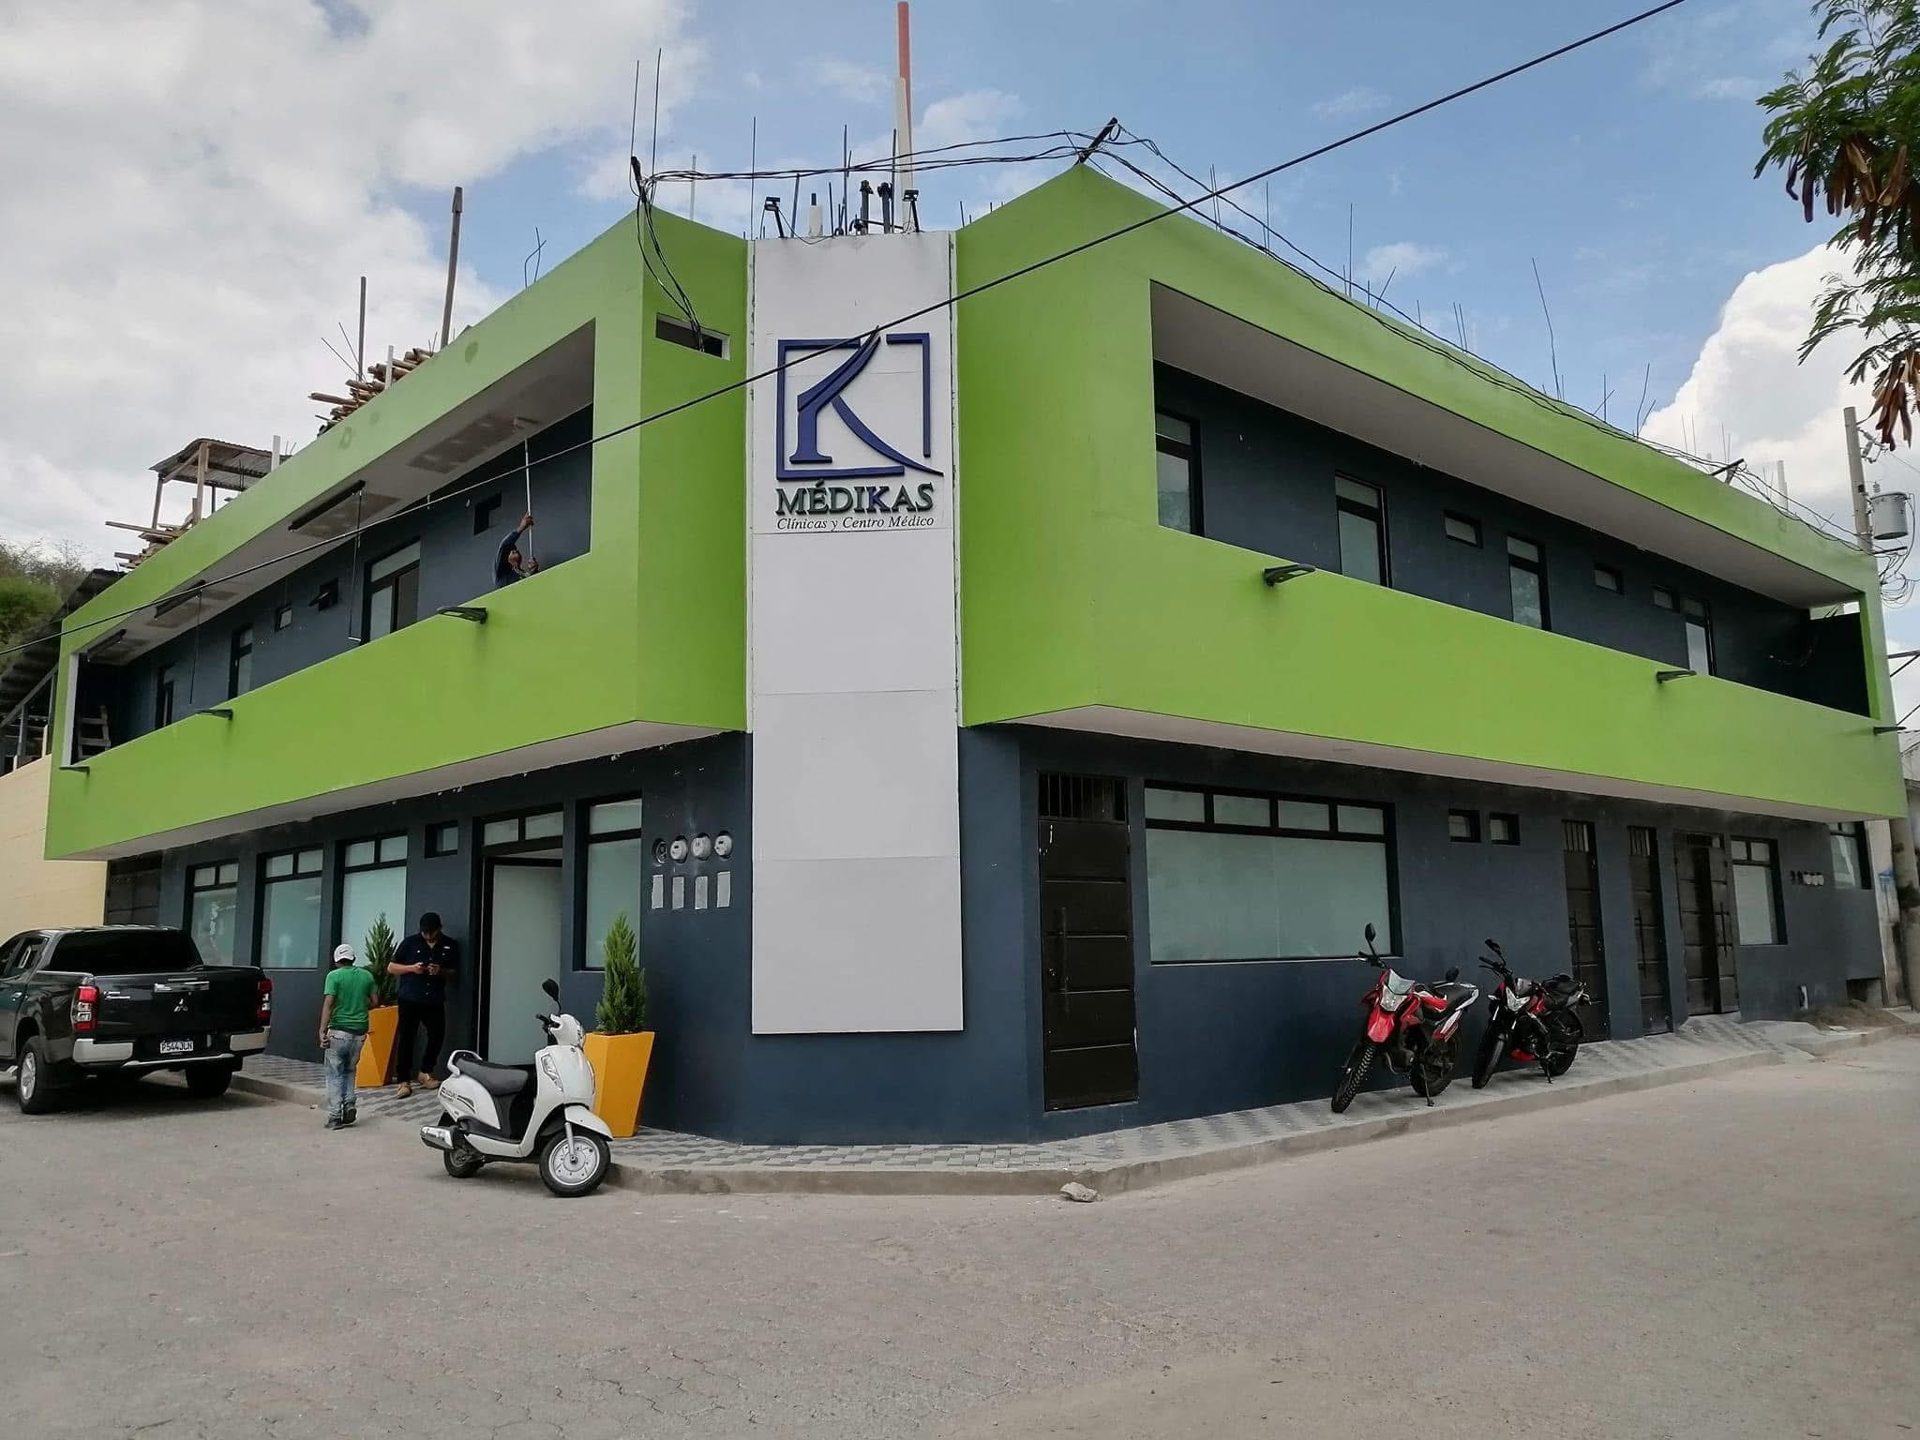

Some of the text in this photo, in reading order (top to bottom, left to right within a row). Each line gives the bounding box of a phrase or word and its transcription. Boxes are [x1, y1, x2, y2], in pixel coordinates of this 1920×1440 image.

[776, 480, 934, 515] MÉDIKAS
[777, 515, 935, 532] Clínicas y Centro Médico
